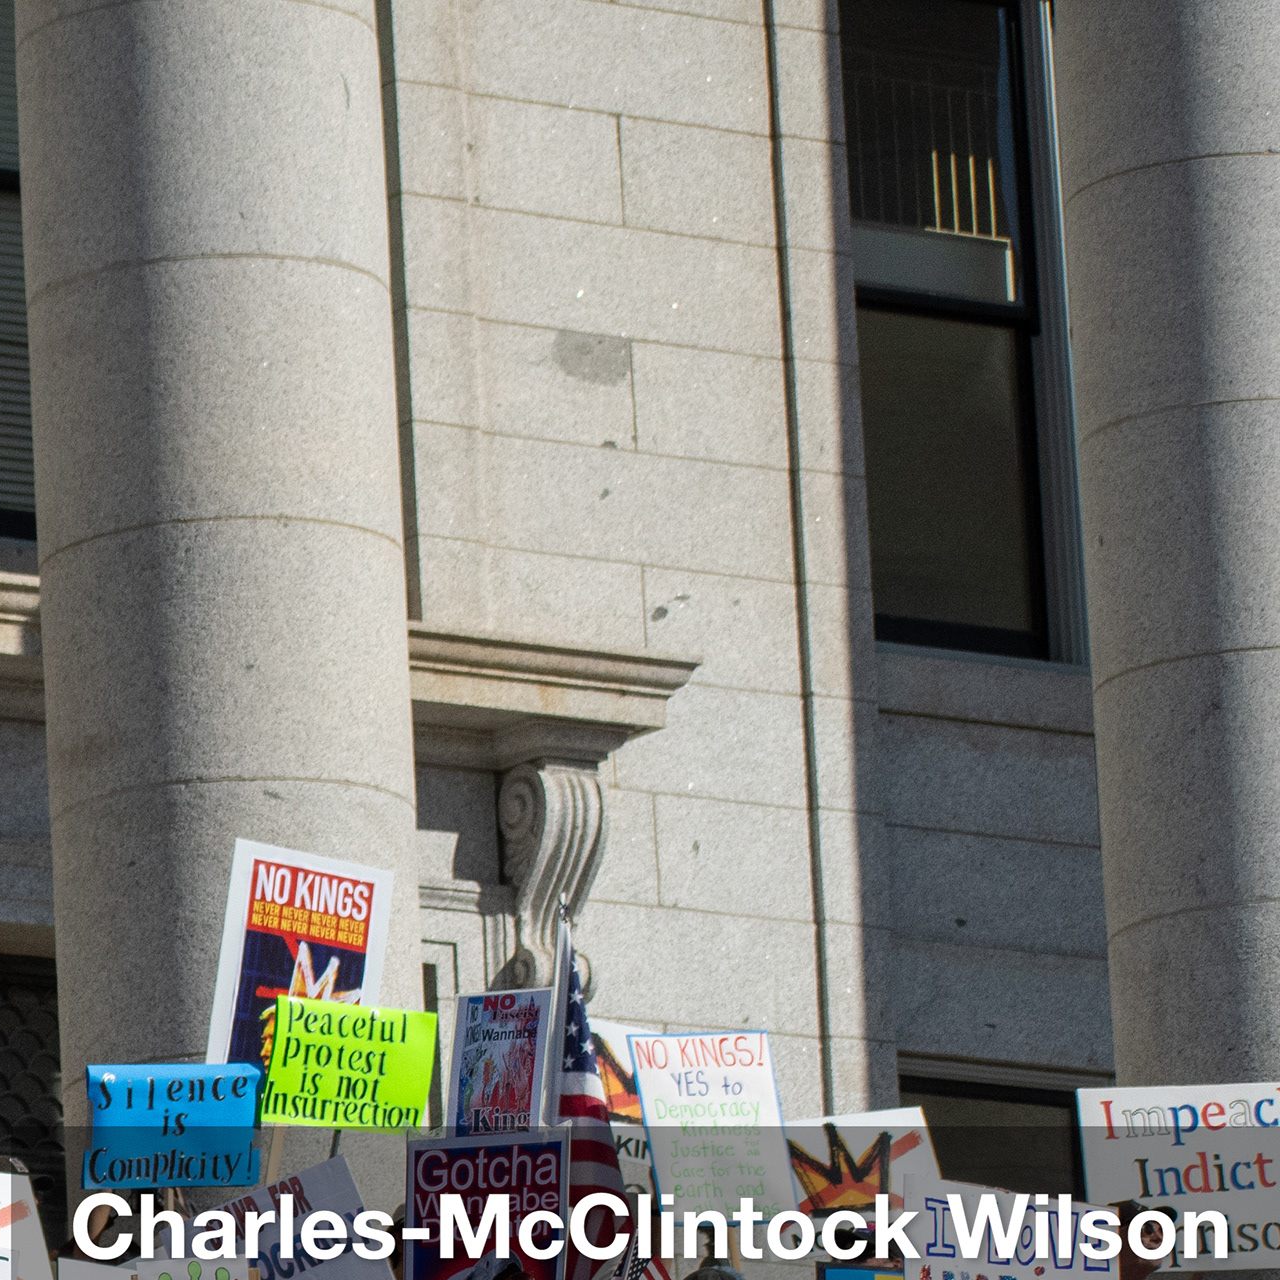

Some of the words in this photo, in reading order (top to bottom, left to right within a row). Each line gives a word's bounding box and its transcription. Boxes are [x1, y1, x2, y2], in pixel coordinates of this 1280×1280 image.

[255, 863, 291, 905] NO
[295, 871, 369, 921] KINGS
[251, 913, 279, 929] NEVER
[280, 919, 307, 935] NEVER
[309, 924, 336, 940] NEVER
[337, 932, 363, 946] NEVER
[253, 901, 280, 917] NEVER
[281, 906, 309, 922] NEVER
[310, 911, 337, 927] NEVER
[339, 918, 365, 934] NEVER
[483, 994, 516, 1011] NO
[287, 999, 407, 1044] Peaceful
[481, 1028, 537, 1042] Wannabe
[634, 1039, 668, 1070] NO
[676, 1033, 765, 1068] KINGS!
[96, 1072, 249, 1111] Silence
[299, 1069, 323, 1095] is
[335, 1075, 380, 1102] not
[670, 1071, 710, 1098] YES
[721, 1075, 743, 1096] to
[161, 1107, 188, 1137] is
[471, 1106, 531, 1133] King
[654, 1098, 761, 1121] Democracy
[416, 1142, 558, 1192] Gotcha
[1133, 1151, 1278, 1199] Indict
